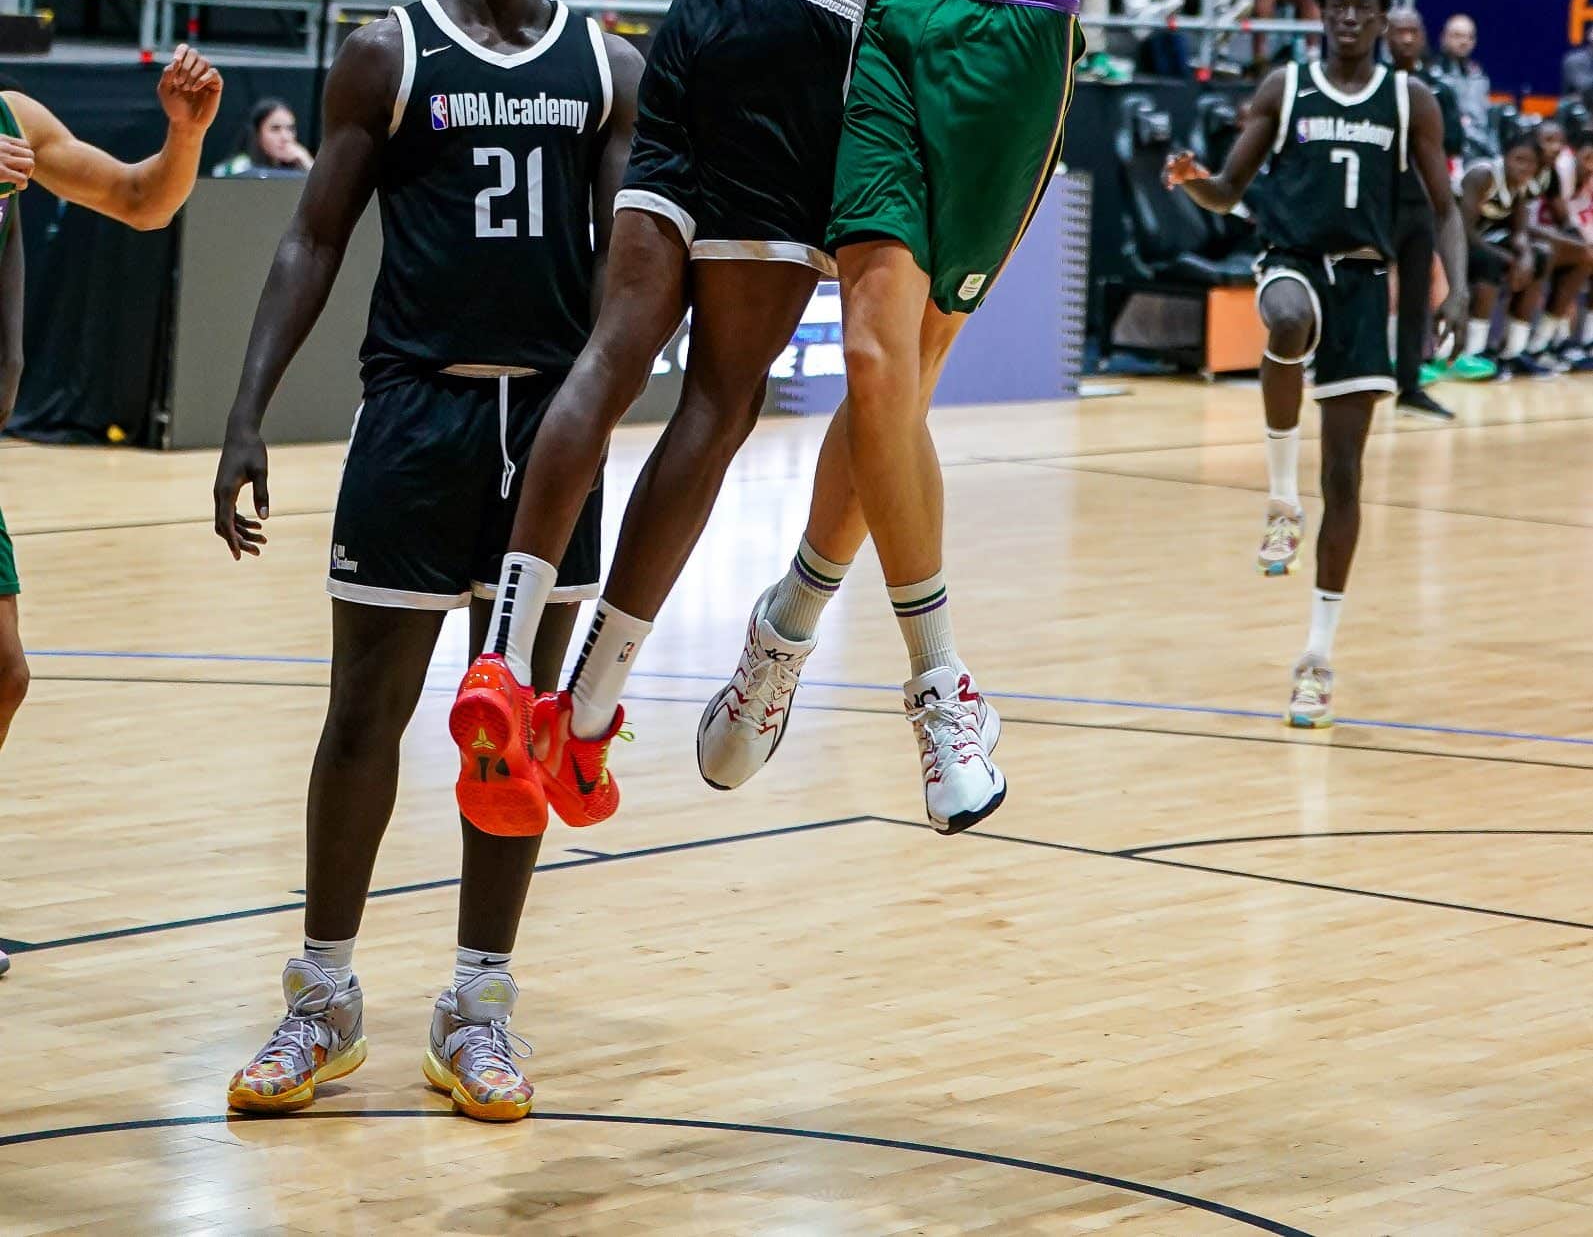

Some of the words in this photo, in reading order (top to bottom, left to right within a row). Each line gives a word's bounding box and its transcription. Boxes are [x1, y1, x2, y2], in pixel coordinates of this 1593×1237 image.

[449, 92, 492, 128] NBA
[494, 91, 589, 134] Academy
[473, 146, 544, 238] 21
[1329, 147, 1360, 209] 7
